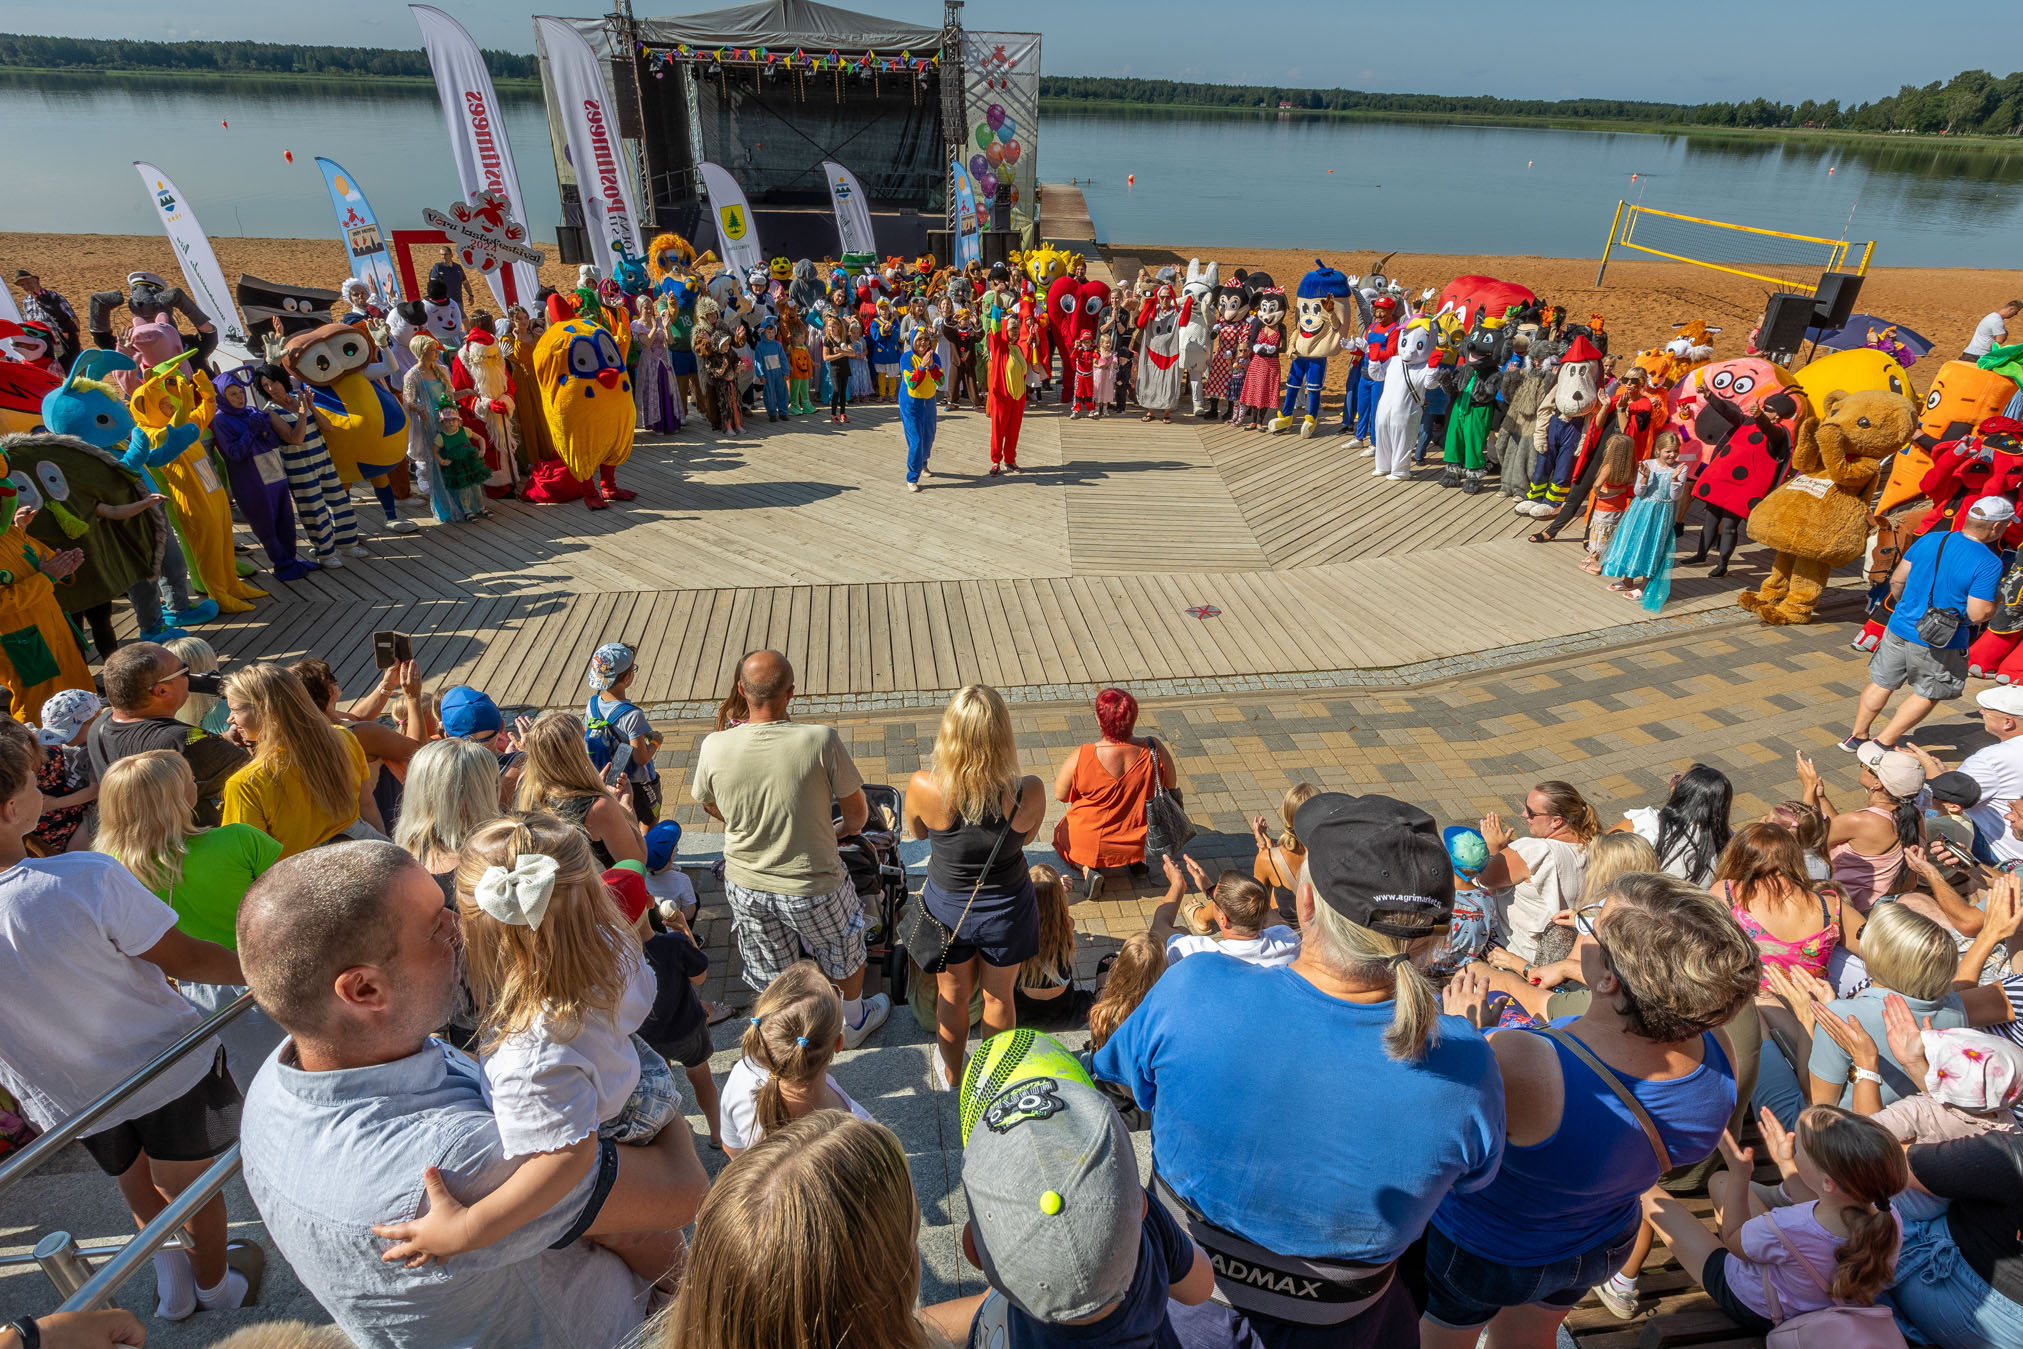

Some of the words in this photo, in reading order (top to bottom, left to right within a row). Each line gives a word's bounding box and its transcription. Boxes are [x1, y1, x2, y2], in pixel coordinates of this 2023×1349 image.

[427, 212, 458, 230] Võru
[461, 226, 541, 263] lastefestival
[470, 239, 498, 252] 2024
[679, 315, 693, 327] 18
